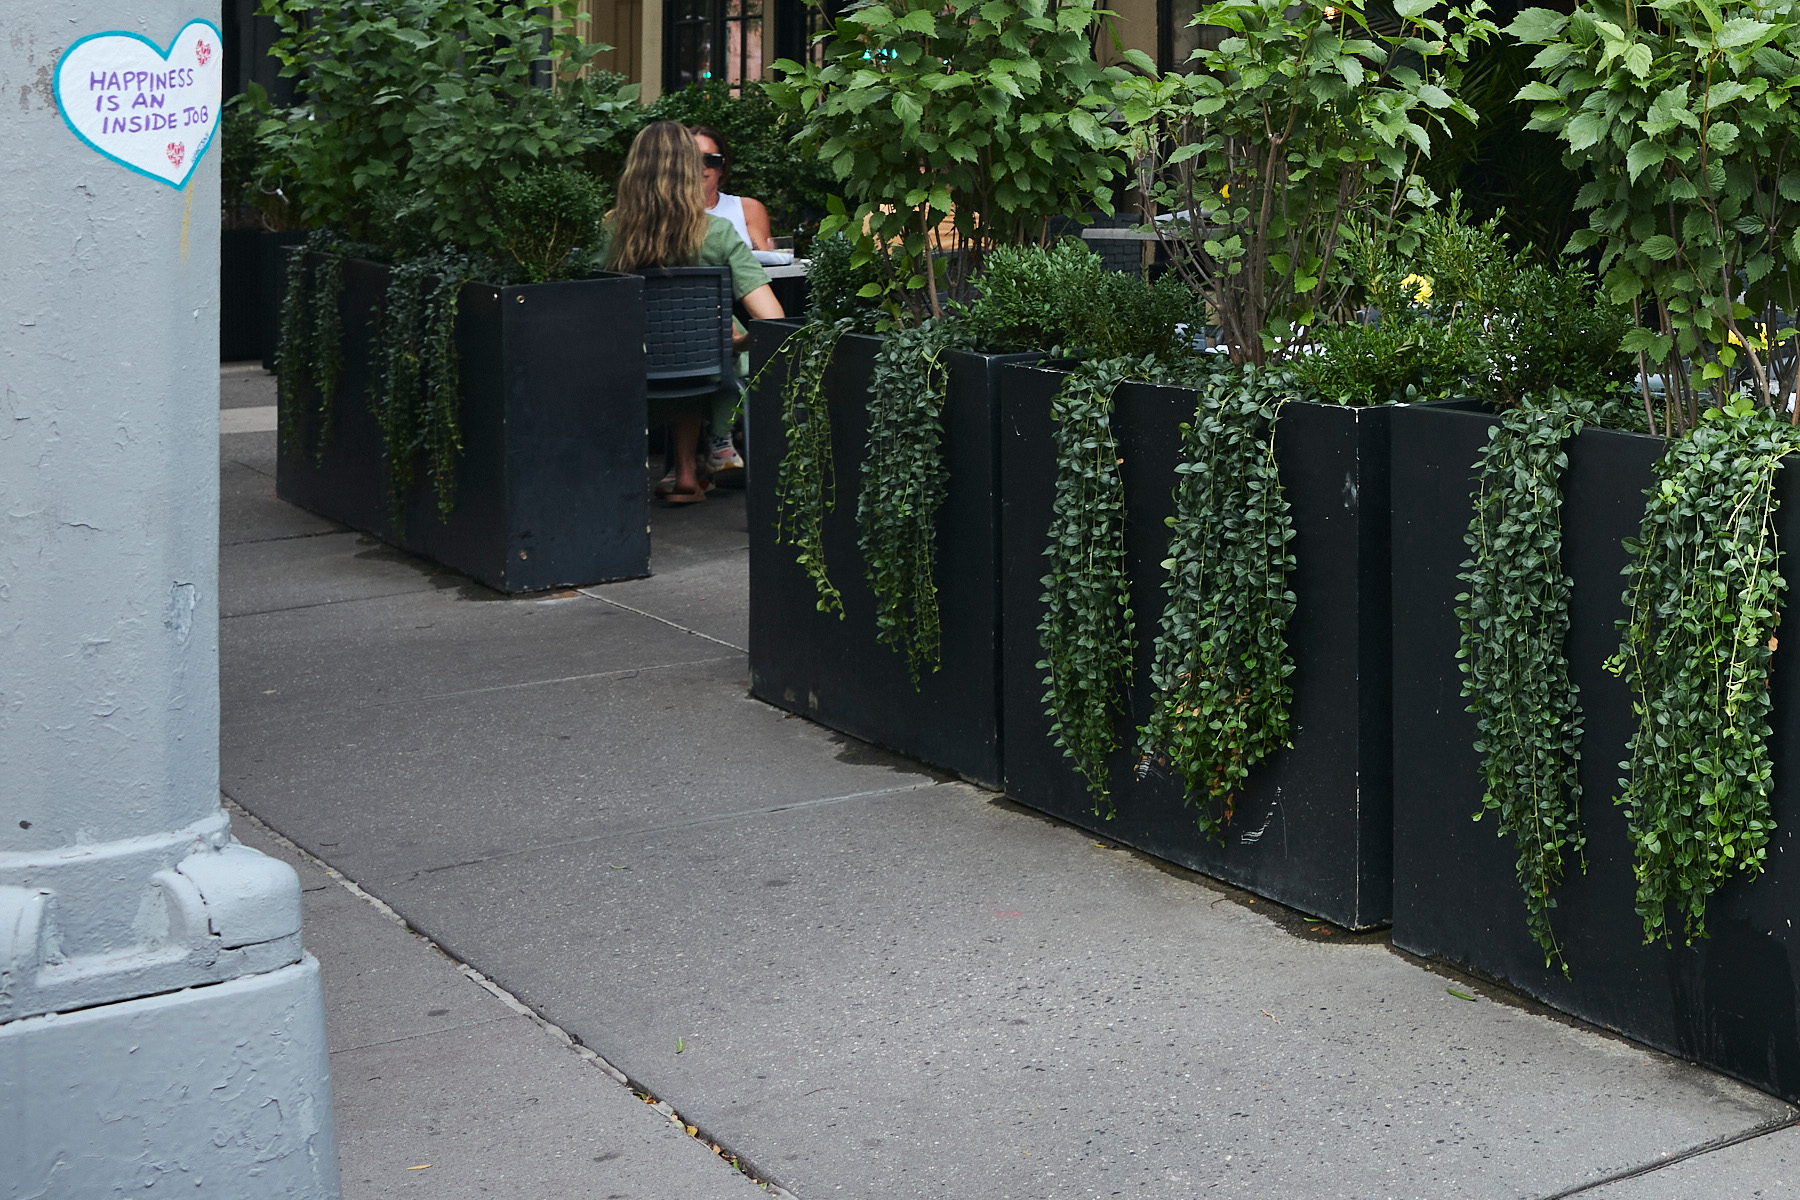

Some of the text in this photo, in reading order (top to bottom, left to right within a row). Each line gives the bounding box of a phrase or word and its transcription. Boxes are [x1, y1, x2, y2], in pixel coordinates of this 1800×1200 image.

[89, 68, 194, 91] HAPPINESS
[96, 92, 165, 112] IS AN
[102, 105, 209, 134] INSIDE JOB
